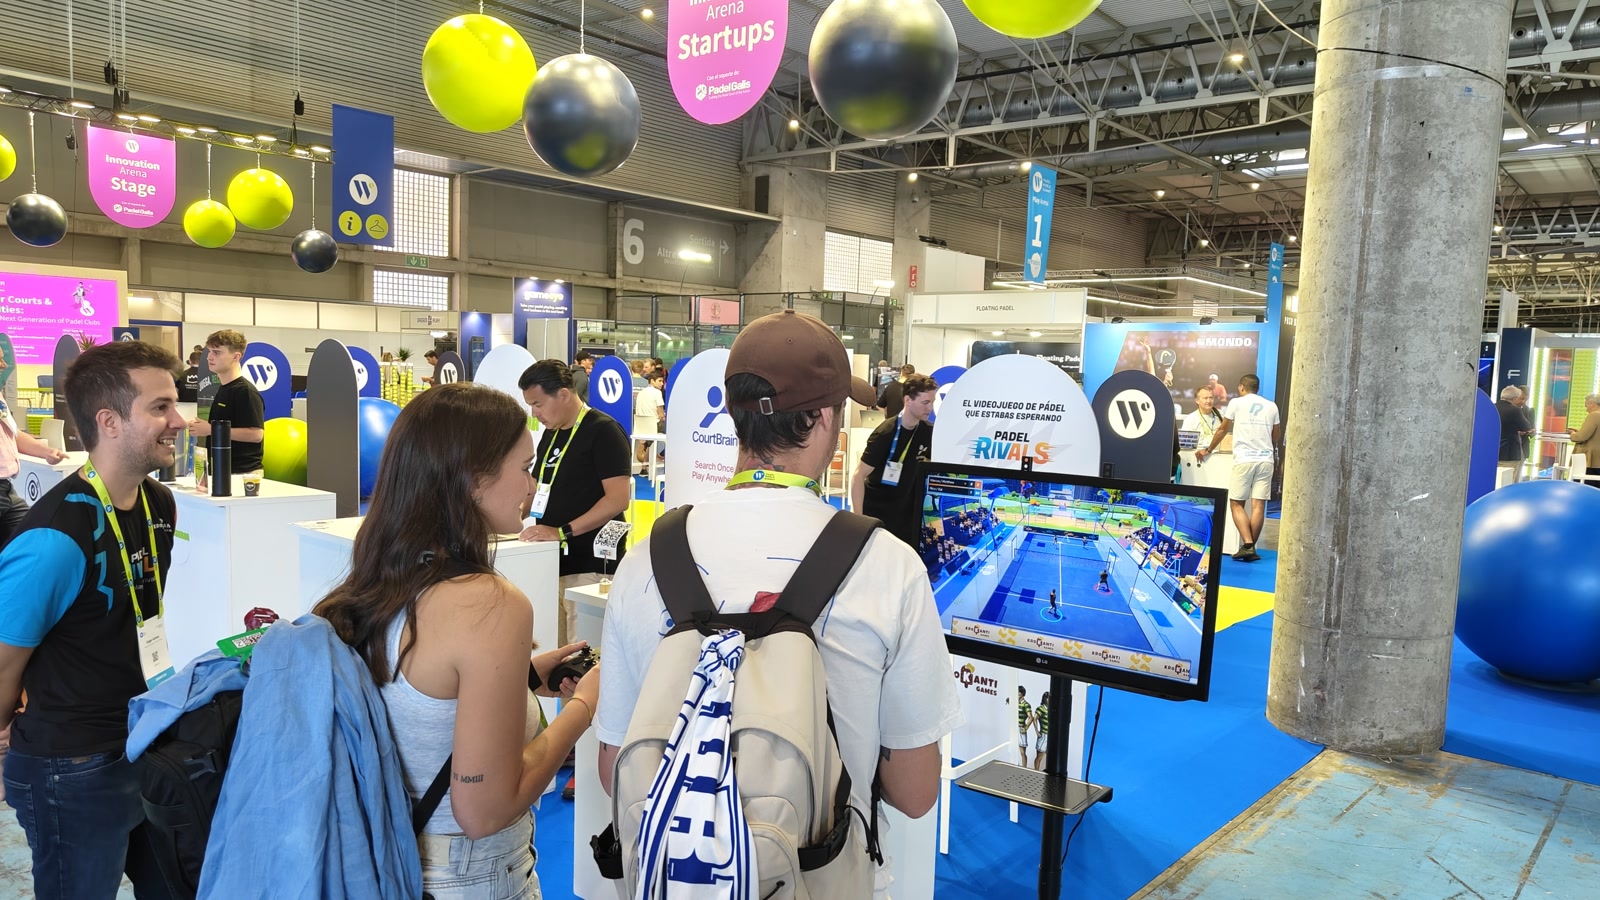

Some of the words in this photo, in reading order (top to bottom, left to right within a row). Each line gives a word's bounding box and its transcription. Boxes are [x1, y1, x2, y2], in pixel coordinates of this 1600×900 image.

[706, 0, 744, 21] Arena
[678, 20, 774, 60] Startups
[106, 154, 160, 170] Innovation
[120, 166, 147, 178] Arena
[111, 176, 156, 197] Stage
[1032, 214, 1042, 248] 1
[623, 218, 644, 264] 6
[690, 234, 715, 247] Sortida
[8, 296, 42, 305] Courts
[1205, 338, 1252, 346] MONDO
[974, 400, 1024, 410] VIDEOJUEGO
[1039, 401, 1066, 412] PÁDEL
[965, 410, 980, 418] QUE
[981, 411, 1014, 420] ESTABAS
[1016, 413, 1062, 422] ESPERANDO
[692, 431, 737, 446] CourtBrain
[994, 431, 1030, 442] PADEL
[975, 436, 1050, 465] RIVALS
[695, 460, 716, 470] Search
[717, 463, 734, 473] Once
[692, 471, 704, 481] Play
[706, 473, 731, 484] Anywhe
[976, 686, 997, 696] GAMES
